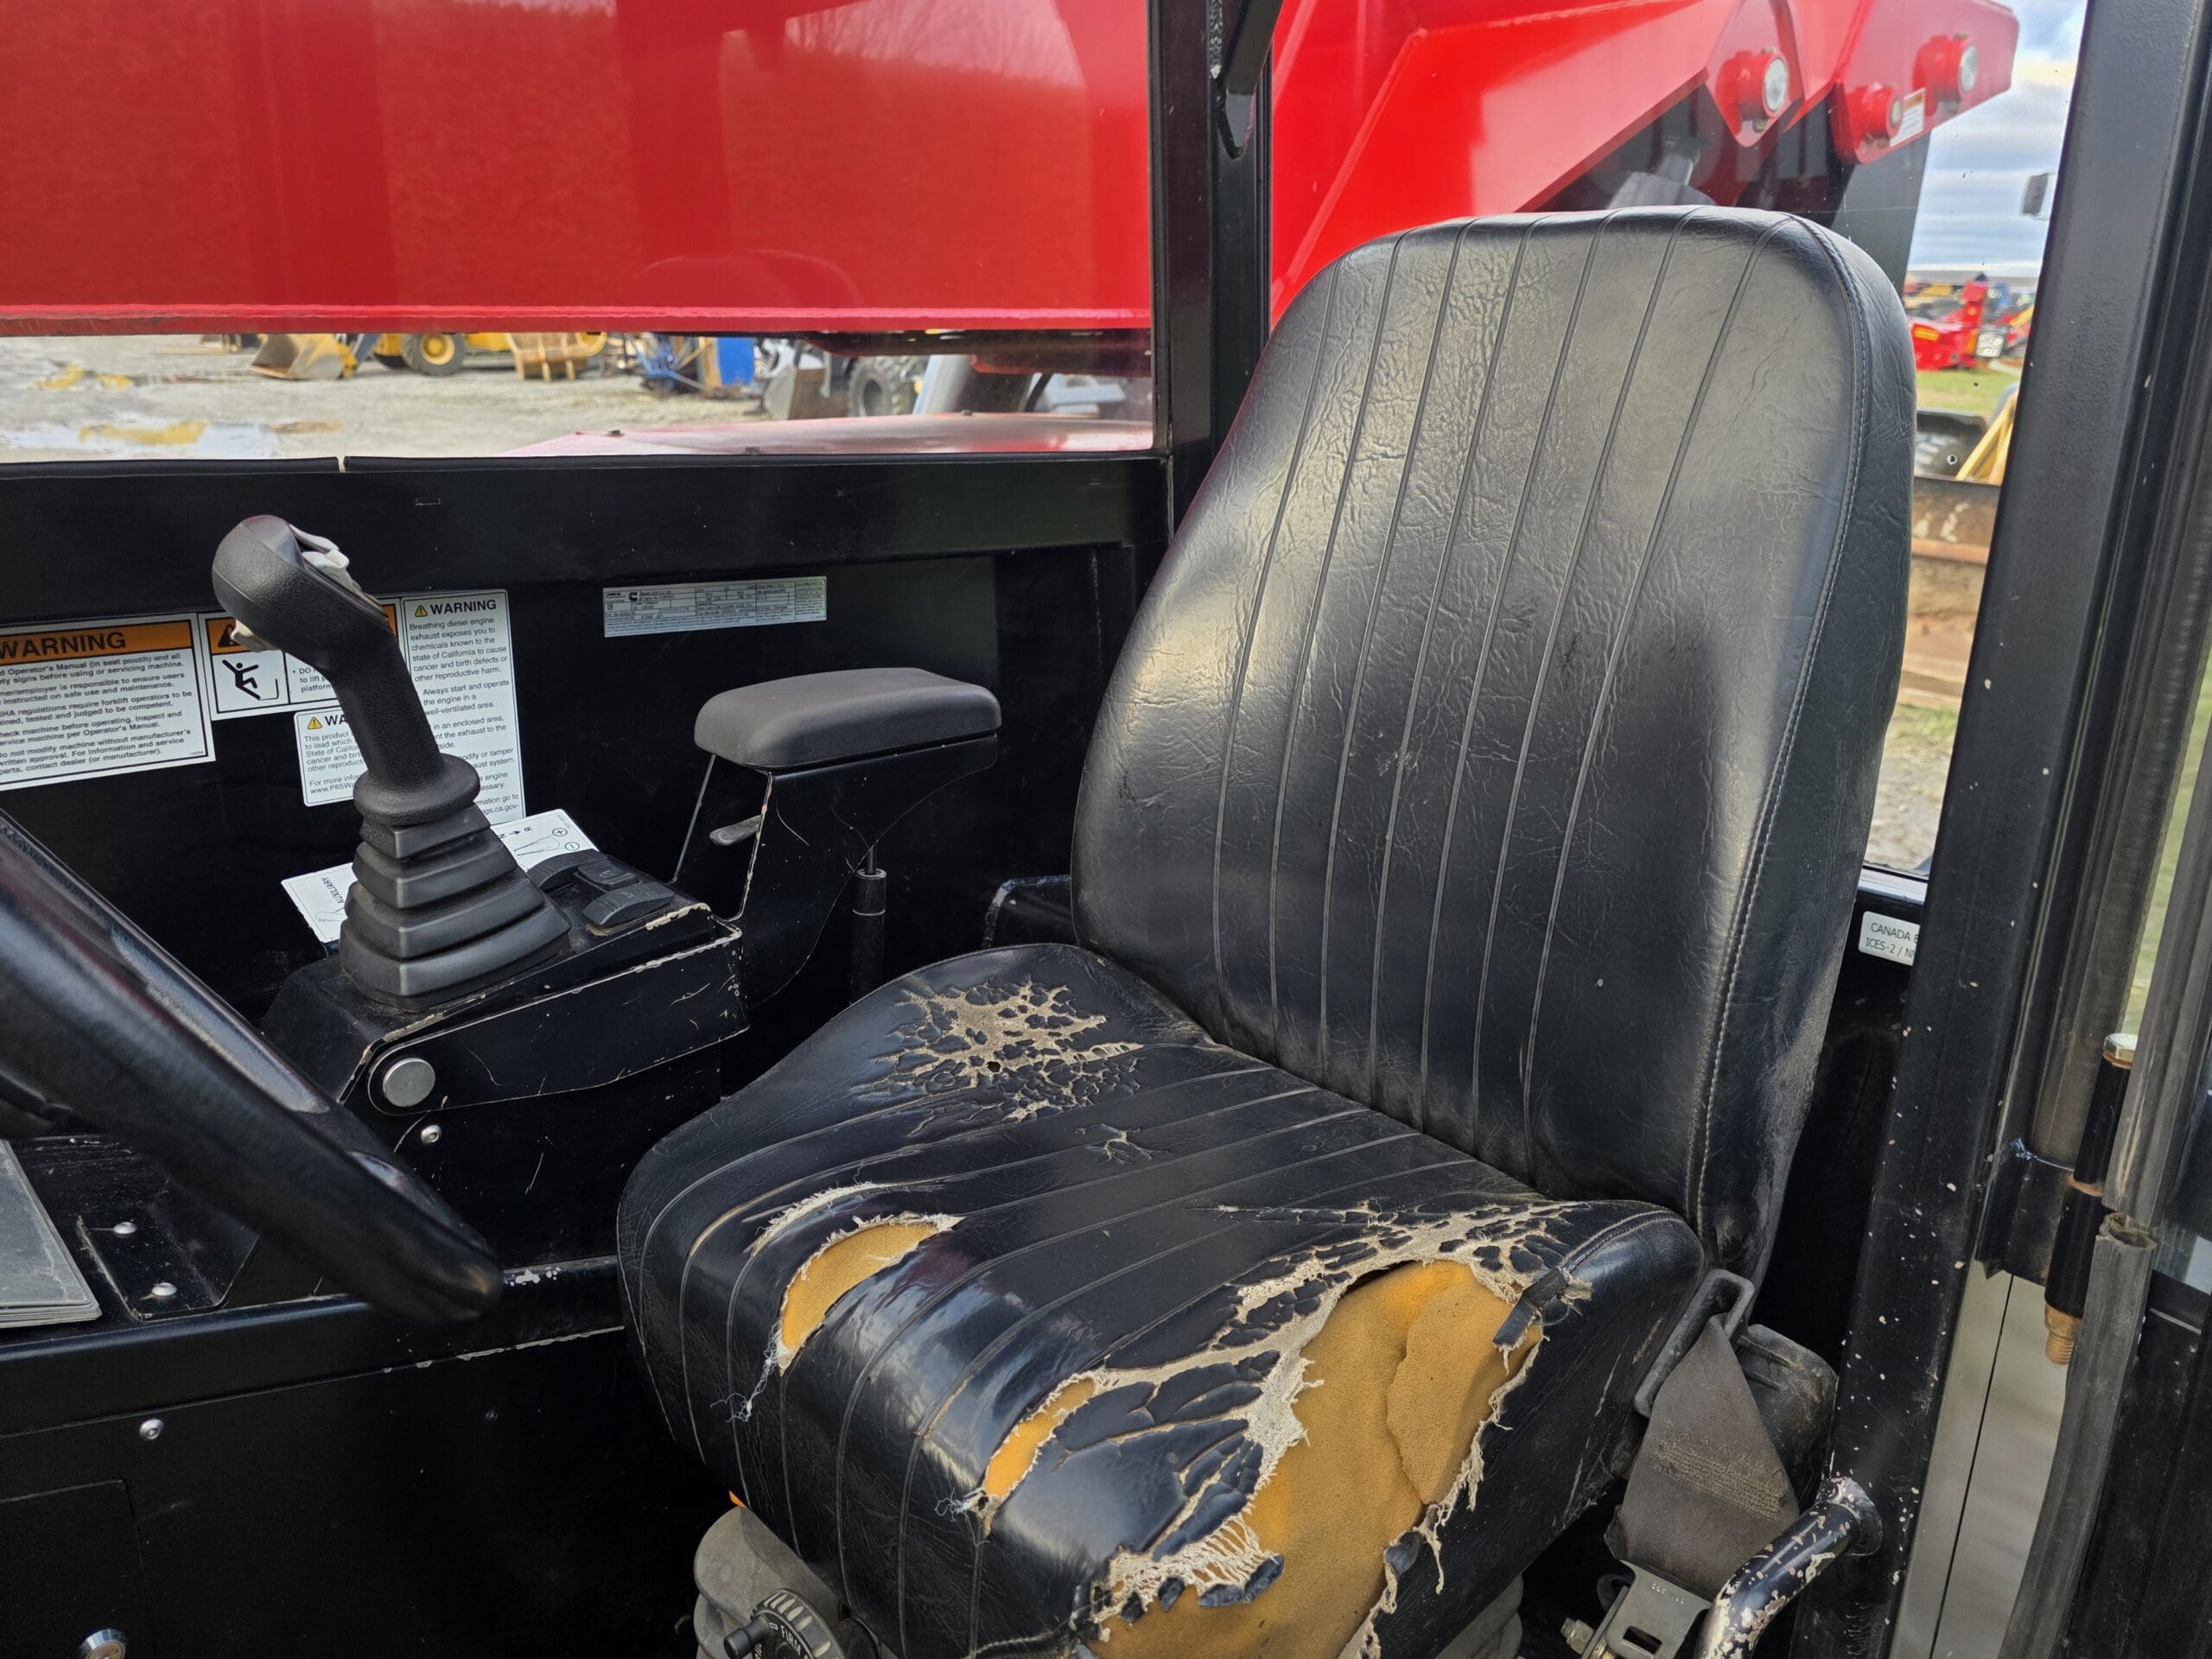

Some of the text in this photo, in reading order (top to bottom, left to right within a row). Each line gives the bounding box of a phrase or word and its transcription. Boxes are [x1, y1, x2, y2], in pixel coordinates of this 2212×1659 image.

[429, 599, 497, 615] WARNING
[410, 617, 494, 631] Breathing diesel engine
[410, 632, 440, 641] exhaust
[442, 629, 472, 639] exposes
[474, 627, 486, 636] you
[0, 631, 126, 659] WARNING
[411, 641, 448, 652] chemicals
[450, 639, 474, 647] known
[442, 648, 476, 658] California
[8, 665, 54, 677] Operator's
[56, 662, 87, 671] Manual
[89, 659, 101, 669] (in
[123, 656, 151, 665] pouch)
[148, 661, 184, 670] machine.
[413, 664, 438, 672] cancer
[440, 661, 454, 670] and
[455, 658, 472, 667] birth
[474, 656, 499, 665] defects
[70, 679, 119, 690] responsible
[132, 675, 161, 683] ensure
[414, 673, 433, 683] other
[435, 669, 480, 680] reproductive
[3, 695, 48, 704] instructed
[120, 681, 175, 692] maintenance.
[423, 688, 449, 697] Always
[483, 679, 510, 690] operate
[17, 704, 67, 715] regulations
[69, 701, 99, 710] require
[101, 696, 129, 706] forklift
[130, 693, 169, 703] operators
[436, 695, 462, 704] engine
[26, 714, 53, 722] tested
[73, 709, 103, 718] judged
[129, 700, 174, 710] competent.
[22, 725, 60, 734] machine
[91, 717, 133, 728] operating.
[135, 713, 165, 722] Inspect
[452, 717, 485, 728] enclosed
[28, 733, 65, 742] machine
[67, 731, 81, 740] per
[83, 725, 127, 736] Operator's
[321, 731, 350, 741] product
[457, 727, 486, 737] exhaust
[27, 746, 56, 755] modify
[59, 741, 95, 750] machine
[98, 737, 129, 746] without
[130, 728, 191, 741] manufacturer's
[331, 738, 353, 747] which
[29, 752, 69, 763] approval.
[88, 744, 136, 755] information
[306, 749, 326, 758] State
[463, 751, 480, 760] odify
[489, 747, 514, 757] tamper
[25, 761, 58, 772] contact
[485, 772, 508, 781] engine
[501, 795, 512, 804] go
[321, 877, 345, 904] AUXILIARY
[1871, 922, 1911, 942] CANADA
[1865, 937, 1896, 955] ICES-2
[780, 1624, 801, 1656] FIRM
